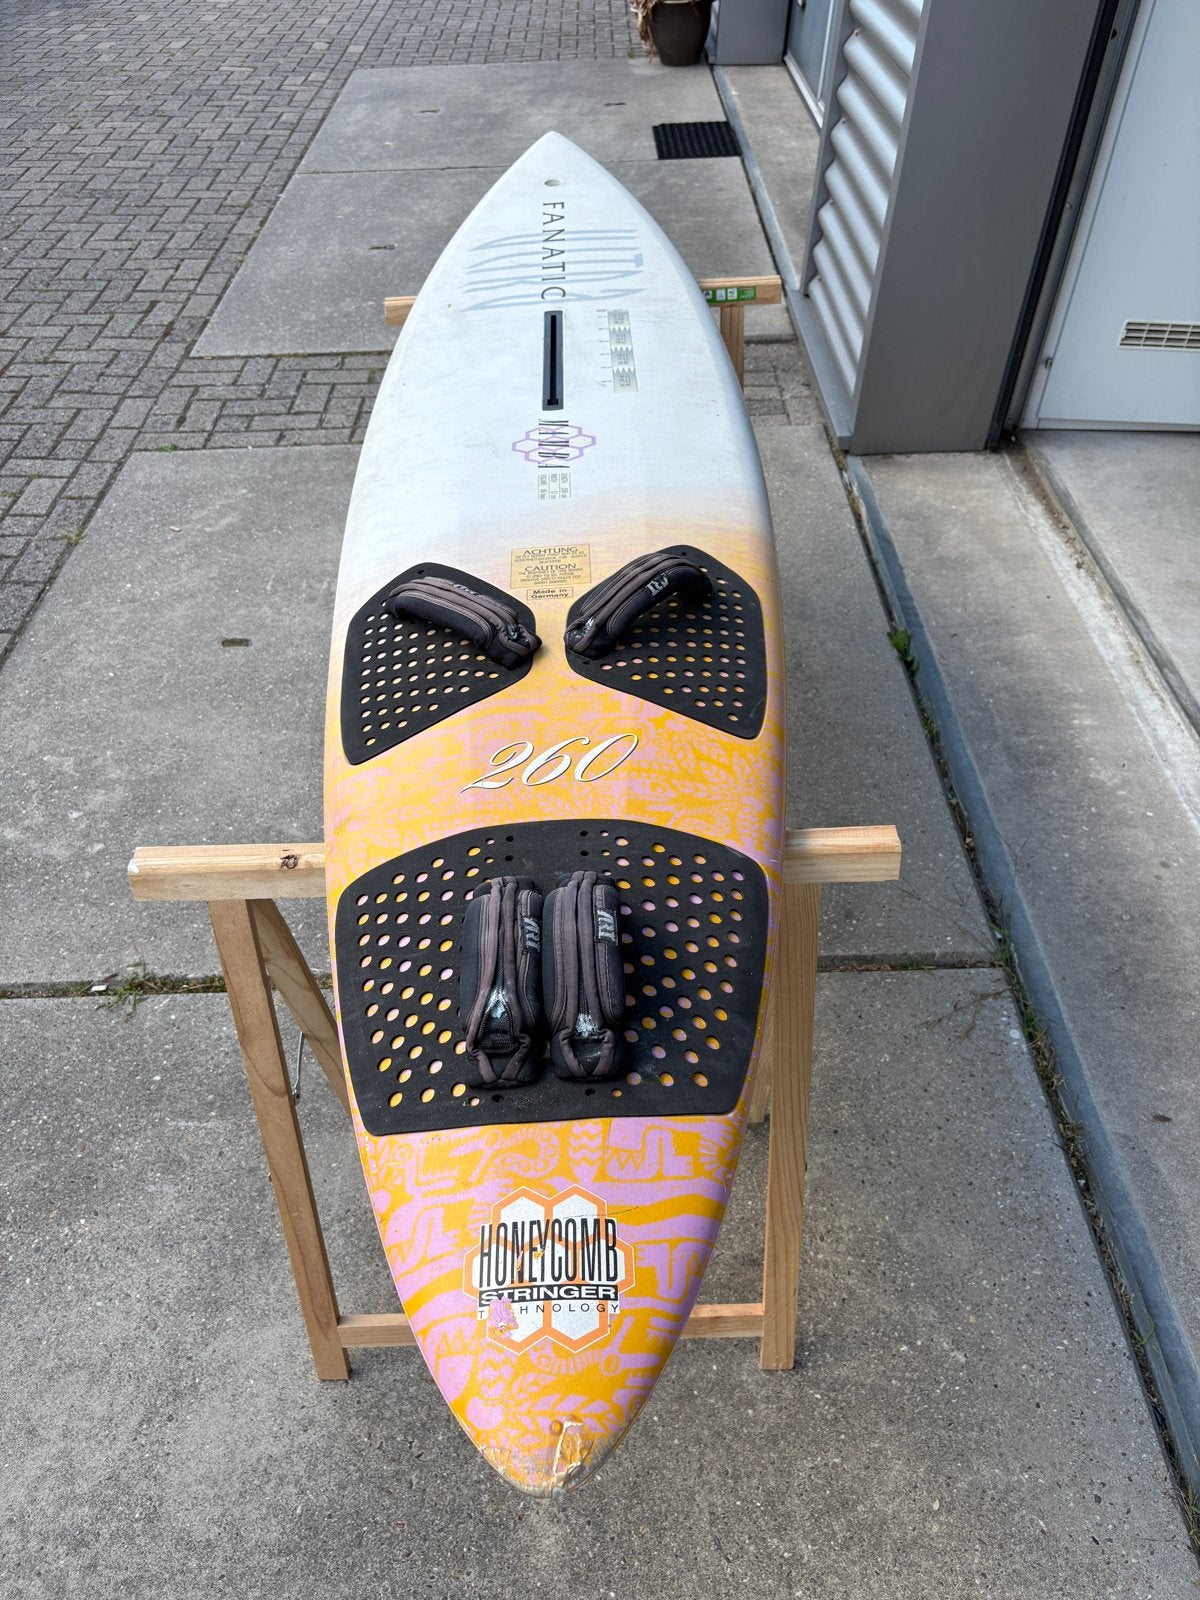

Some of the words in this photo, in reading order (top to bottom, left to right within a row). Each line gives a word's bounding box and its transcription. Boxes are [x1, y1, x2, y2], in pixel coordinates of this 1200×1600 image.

[541, 201, 566, 300] FANATIC
[538, 418, 570, 468] MAMBA
[523, 547, 578, 556] ACHTUNG
[525, 563, 576, 572] CAUTION
[459, 733, 639, 793] 260
[479, 1218, 618, 1288] HONEYCOMB
[478, 1303, 619, 1319] THNOLOGY
[480, 1286, 616, 1306] STRINGER
